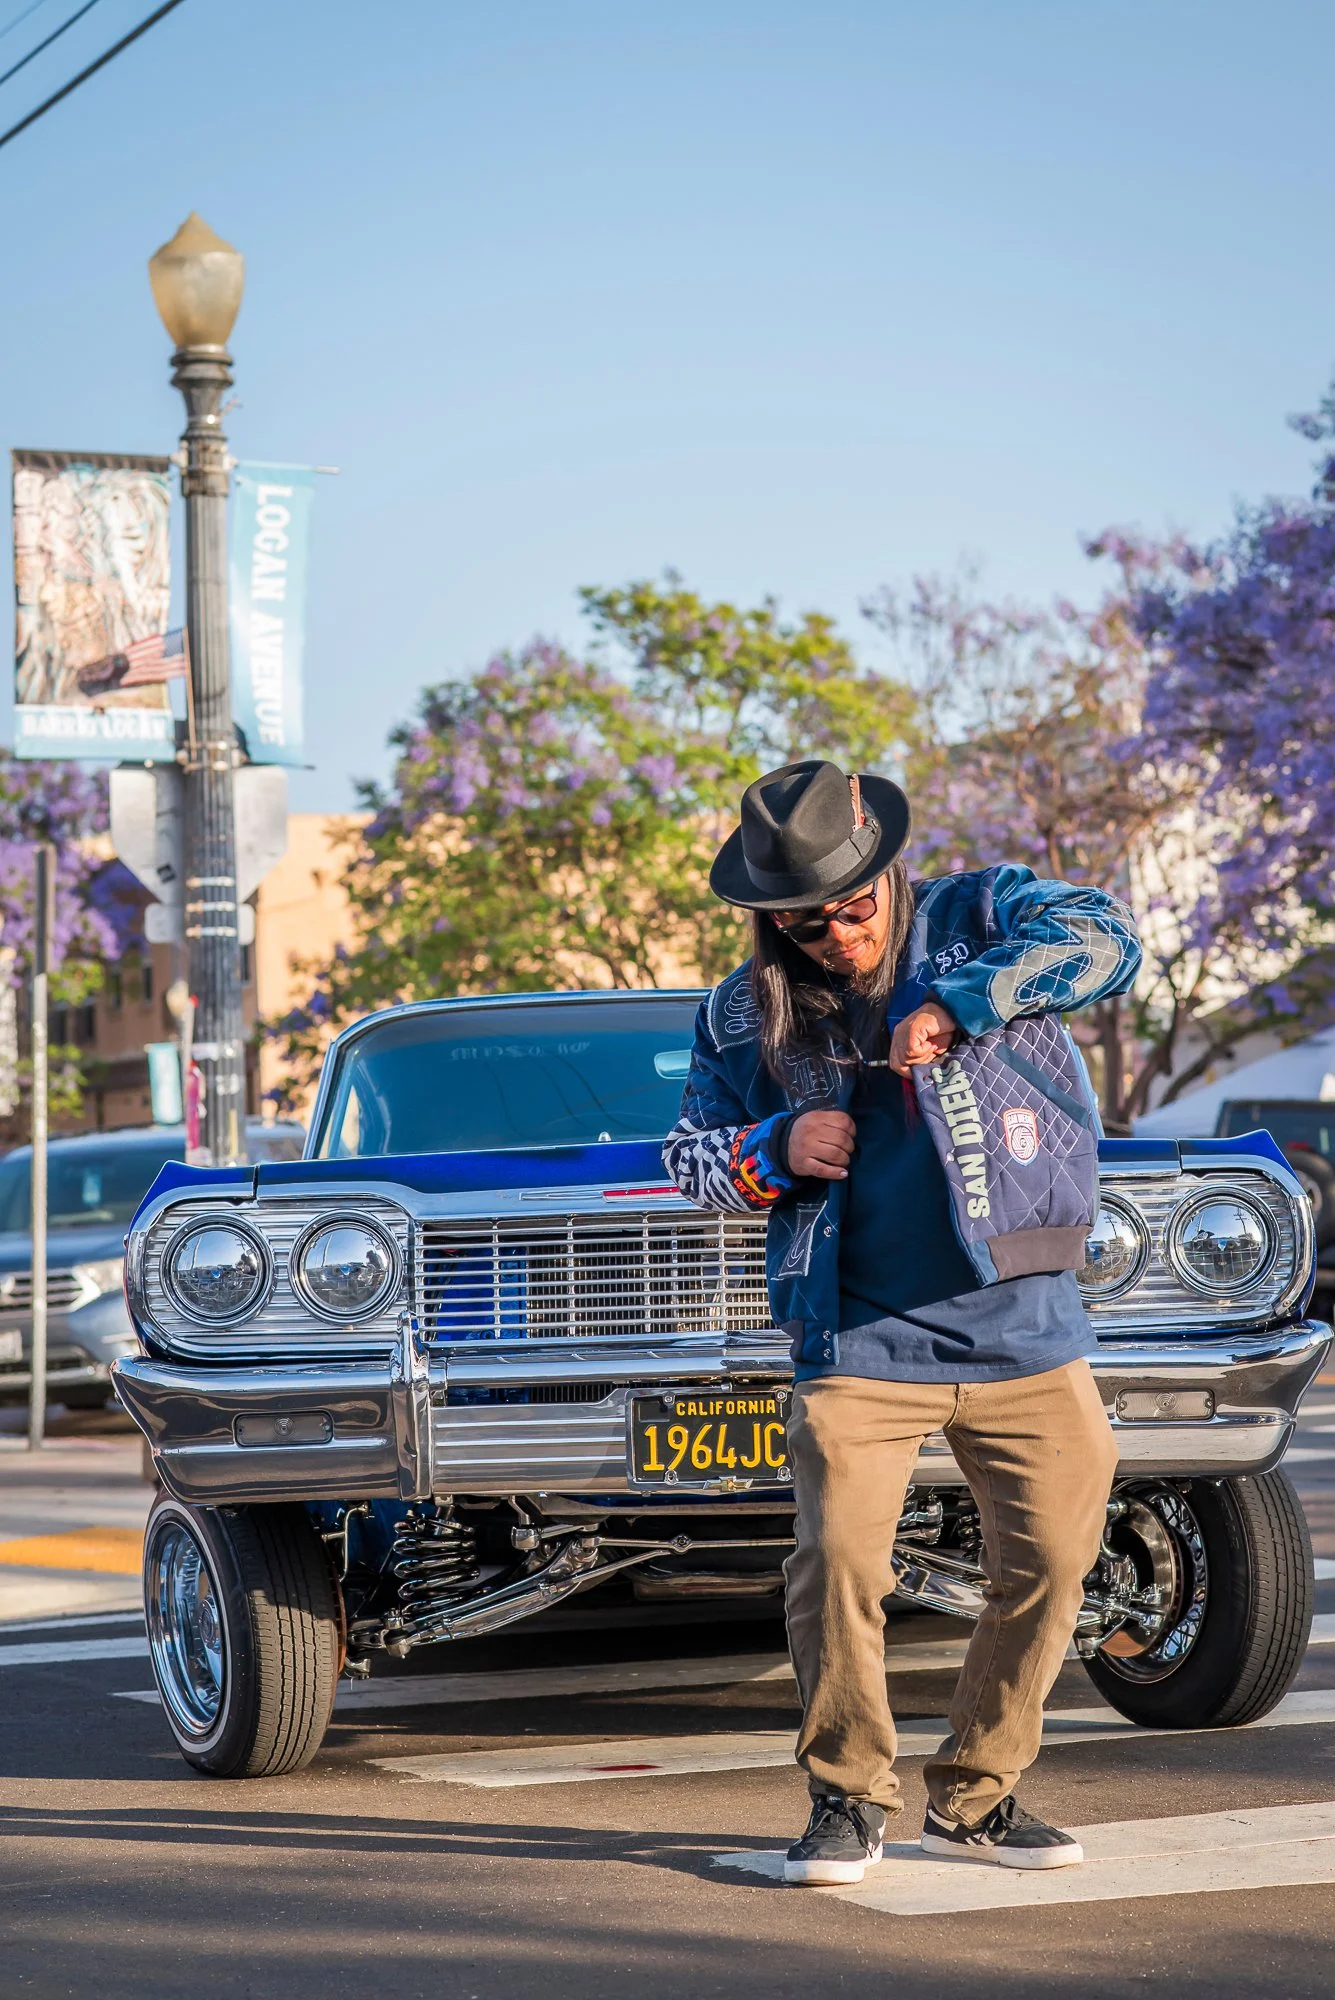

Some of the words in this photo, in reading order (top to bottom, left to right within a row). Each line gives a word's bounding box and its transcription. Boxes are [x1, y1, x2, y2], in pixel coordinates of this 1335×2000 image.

[251, 484, 293, 601] LOGAN
[249, 609, 285, 746] AVENUE
[957, 1152, 990, 1219] SAN
[675, 1400, 777, 1417] CALIFORNIA
[642, 1421, 787, 1472] 1964JC
